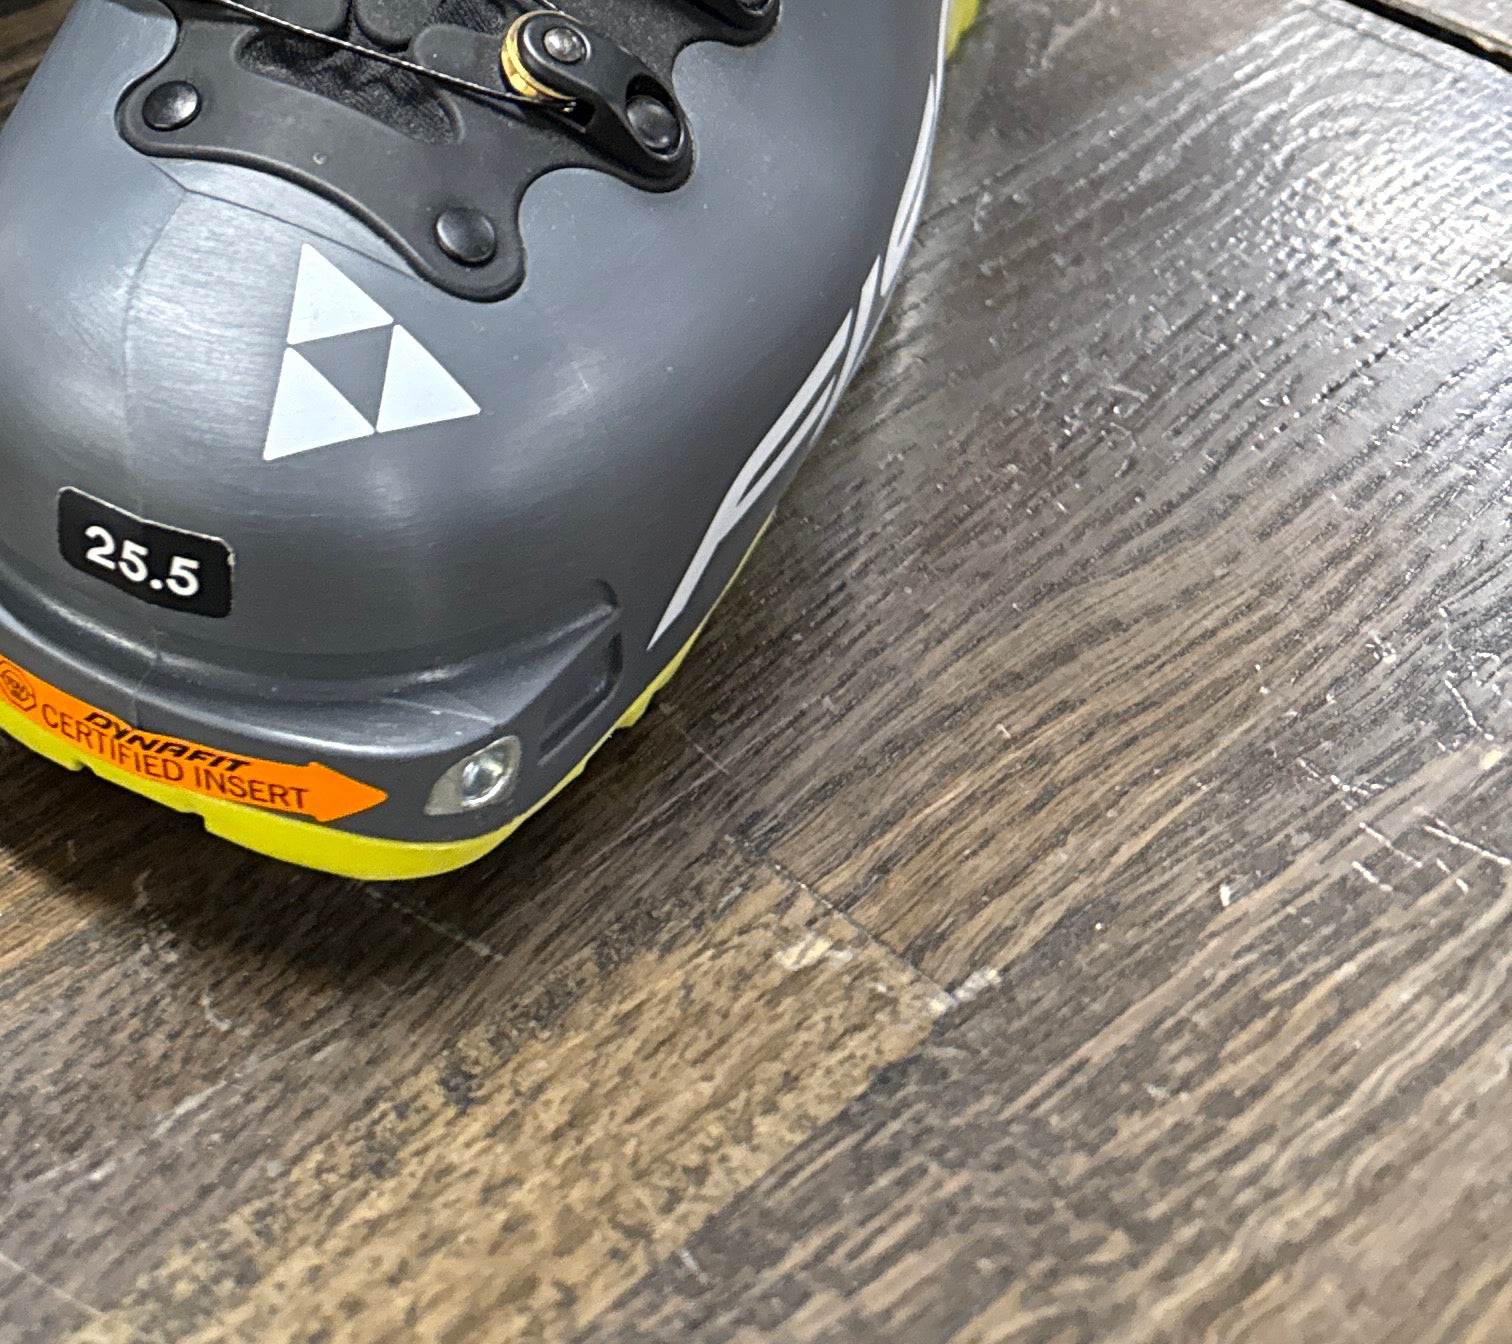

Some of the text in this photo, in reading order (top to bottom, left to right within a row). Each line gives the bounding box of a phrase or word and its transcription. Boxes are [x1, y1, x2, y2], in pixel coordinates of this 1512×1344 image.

[84, 525, 201, 597] 25.5
[41, 703, 309, 809] CERTIFIED INSERT
[84, 711, 250, 772] DYNAFIT
